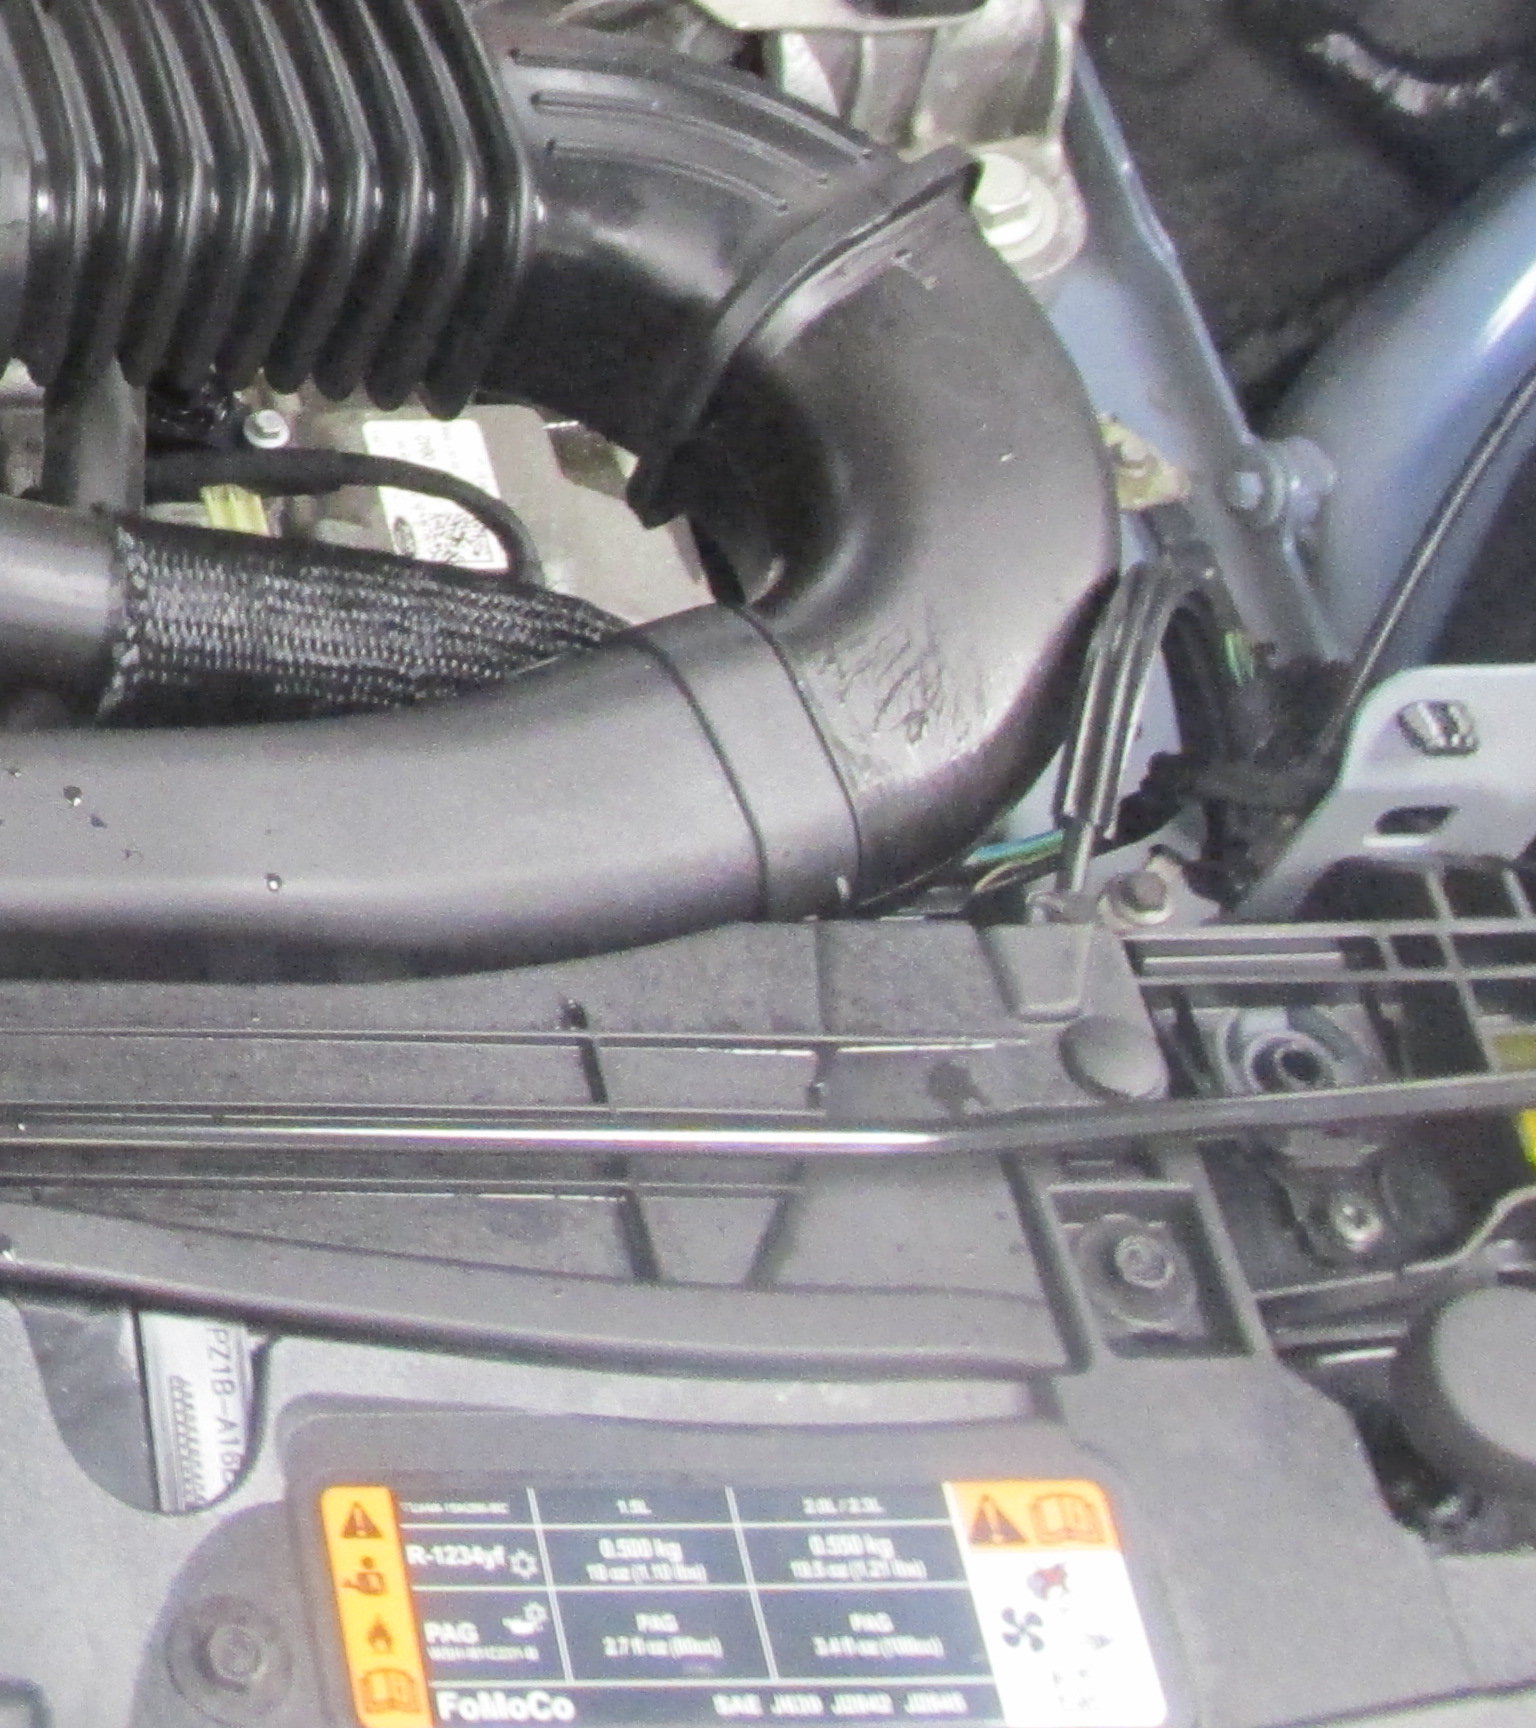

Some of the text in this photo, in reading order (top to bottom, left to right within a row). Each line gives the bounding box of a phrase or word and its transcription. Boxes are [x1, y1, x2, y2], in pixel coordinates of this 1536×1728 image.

[405, 1544, 506, 1571] R-1234yf
[653, 1538, 683, 1563] kg
[423, 1622, 479, 1645] PAG
[635, 1613, 679, 1634] PAG
[848, 1612, 894, 1633] PAG
[435, 1690, 576, 1723] FoMoCo
